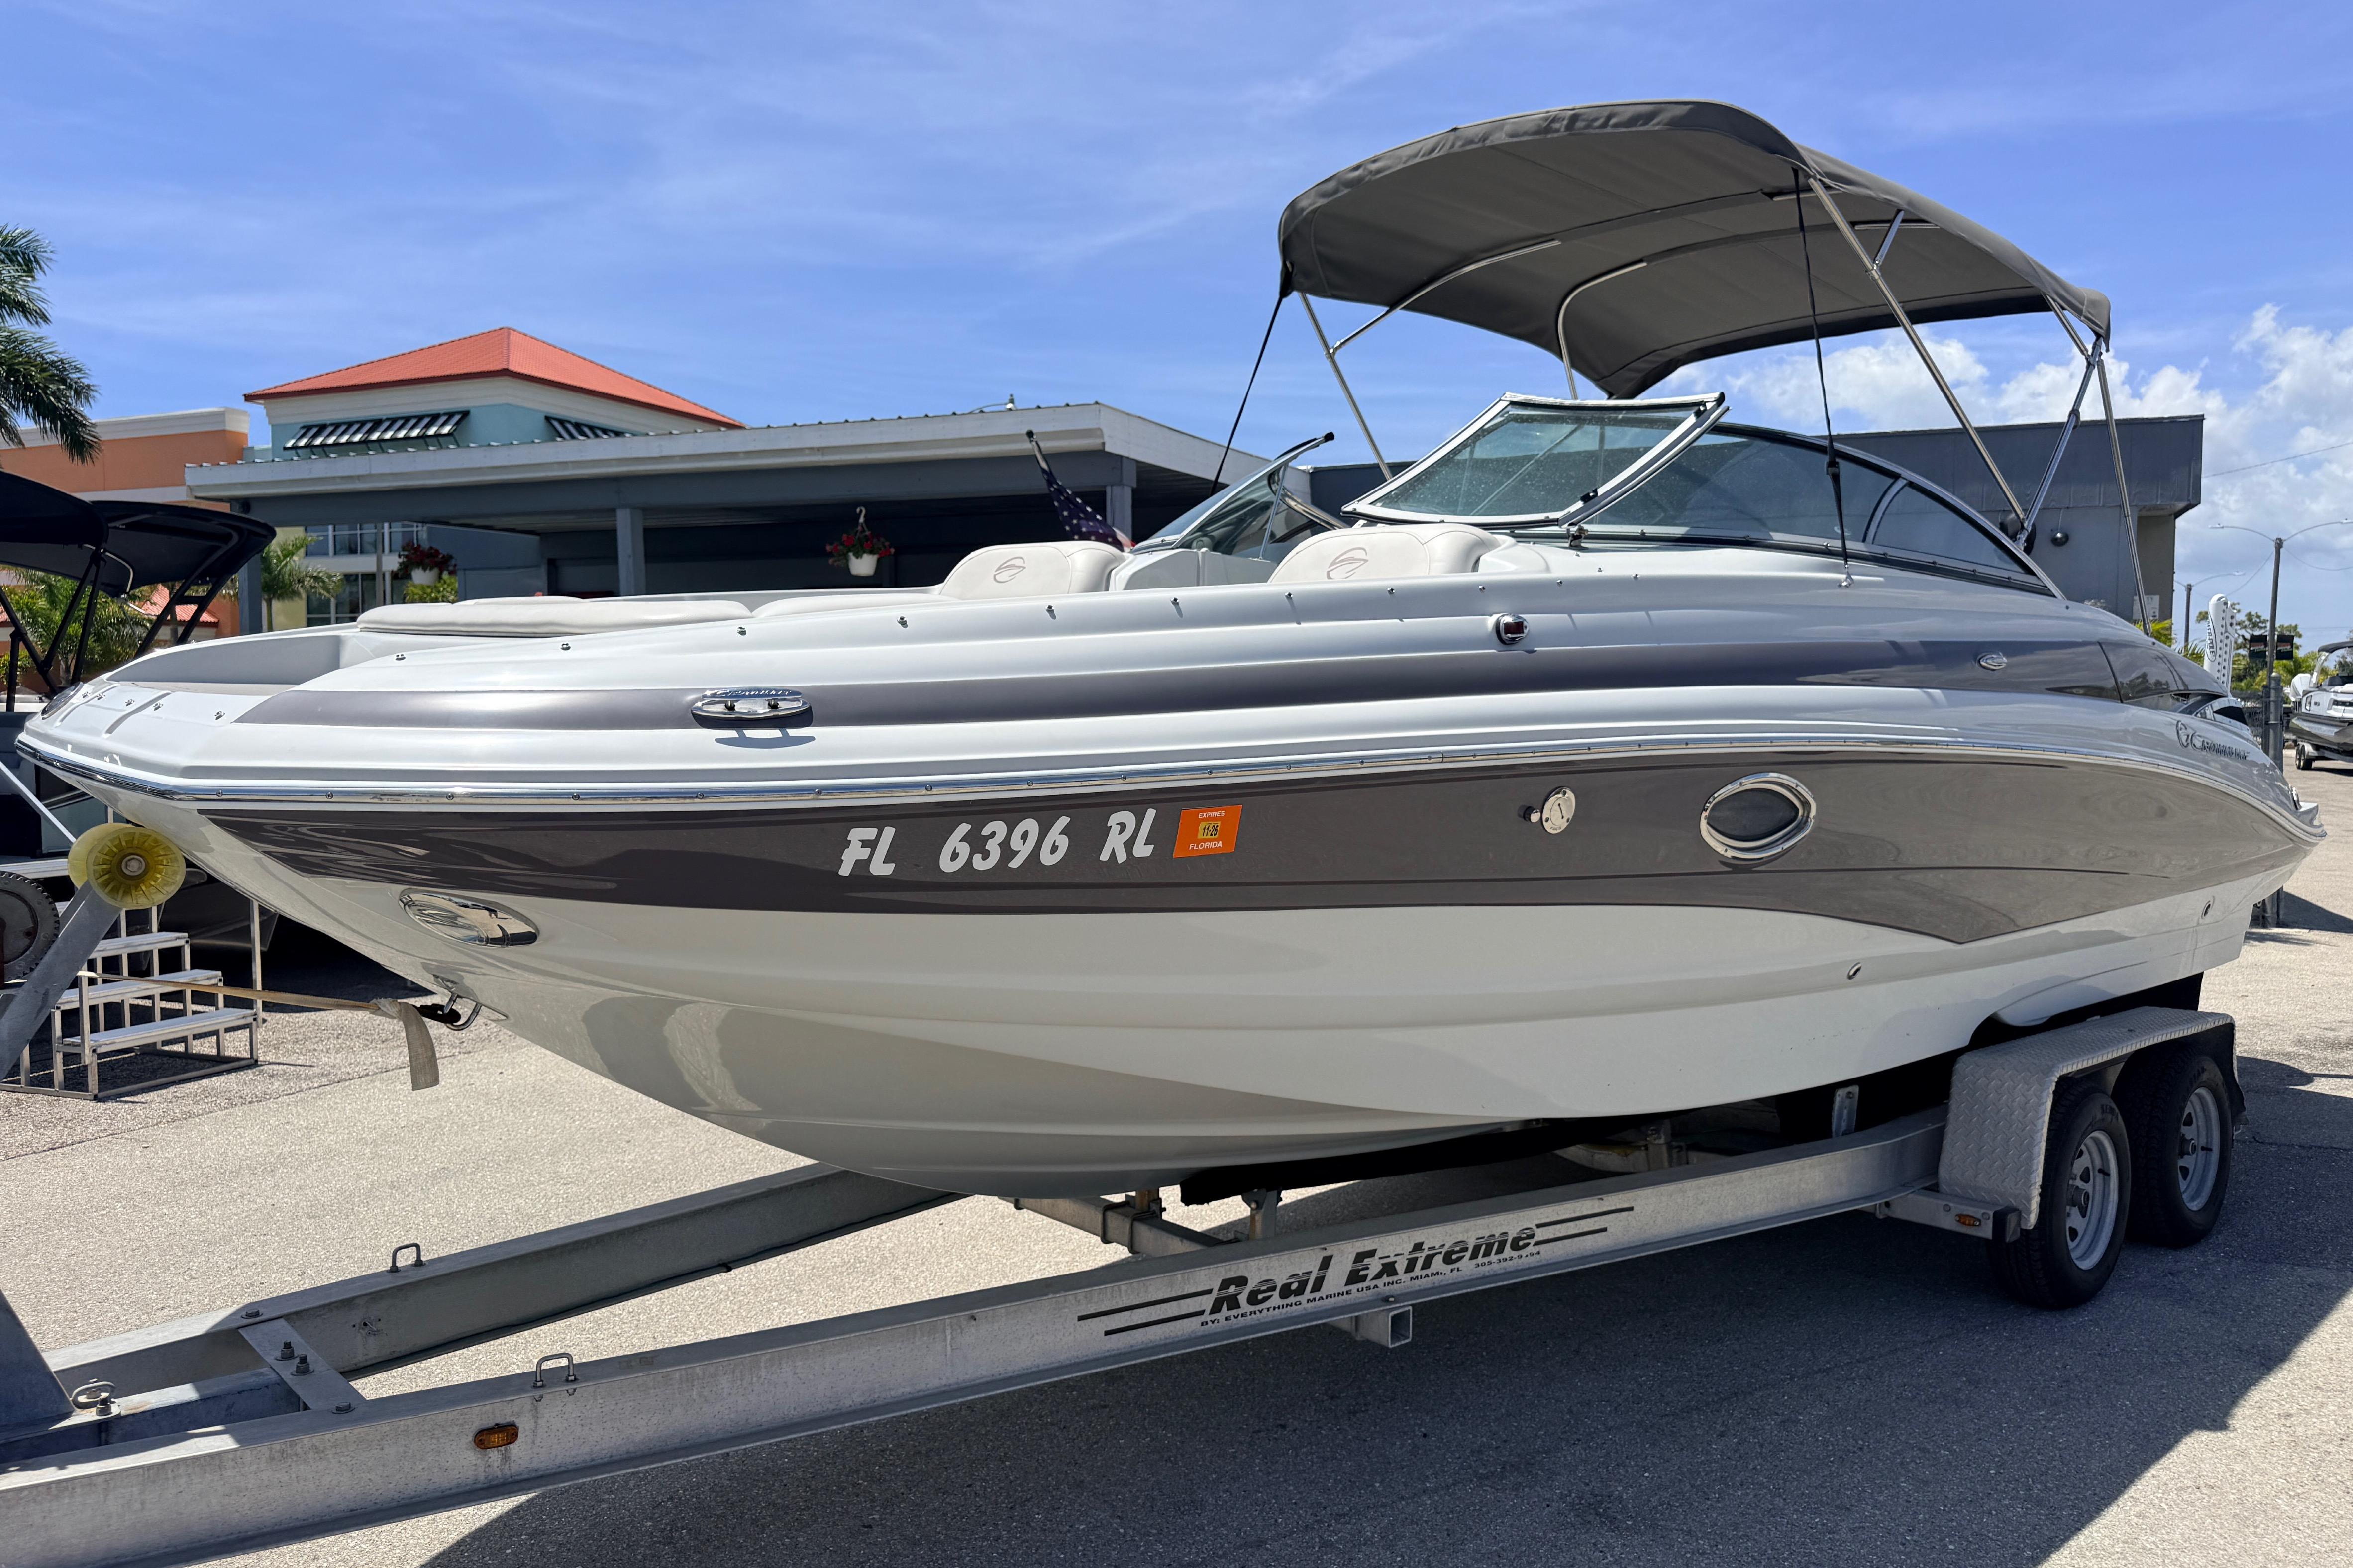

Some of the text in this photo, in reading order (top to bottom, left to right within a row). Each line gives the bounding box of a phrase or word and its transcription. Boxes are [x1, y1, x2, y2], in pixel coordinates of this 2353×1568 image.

[838, 808, 1156, 876] FL 6396 RL
[1189, 841, 1222, 850] FLORIDA
[1209, 1227, 1535, 1315] Real Extreme
[1201, 1318, 1220, 1327] BY:
[1225, 1300, 1302, 1321] EVERYTHING
[1307, 1289, 1352, 1303] MARINE
[1357, 1284, 1379, 1293] USA
[1383, 1278, 1406, 1287] INC.
